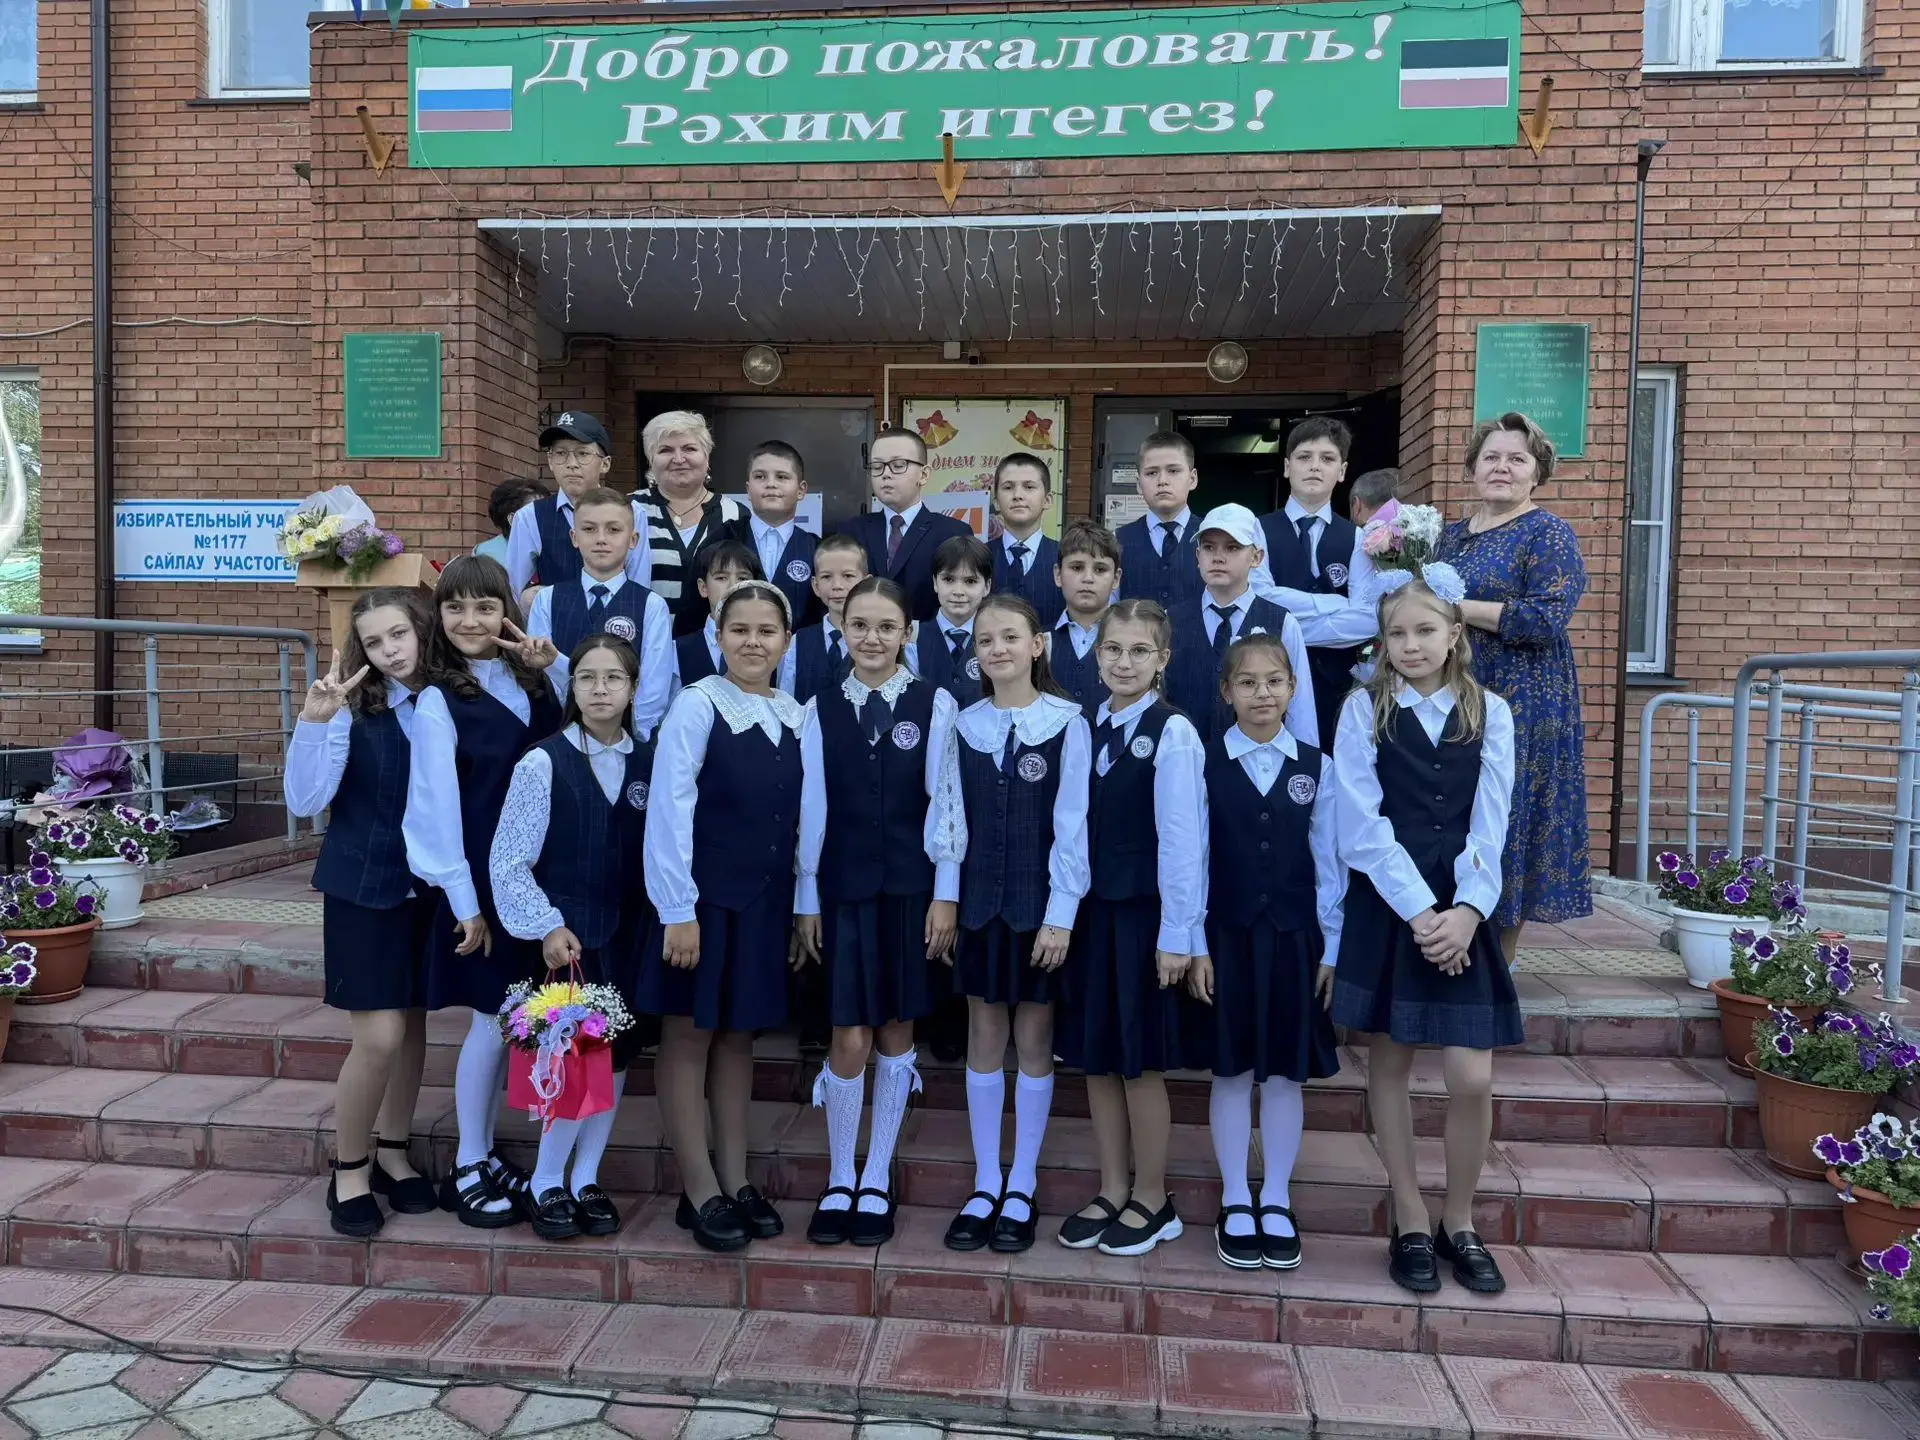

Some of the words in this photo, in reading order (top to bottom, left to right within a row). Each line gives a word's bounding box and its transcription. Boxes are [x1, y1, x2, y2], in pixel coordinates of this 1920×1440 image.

[521, 34, 789, 93] Добро
[814, 14, 1392, 76] пожаловать!
[615, 104, 908, 146] Рәхим
[935, 89, 1274, 138] итегез!
[116, 510, 252, 529] ИЗБИРАТЕЛЬНЫЙ
[194, 534, 247, 550] №1177
[143, 553, 205, 571] САЙЛАУ
